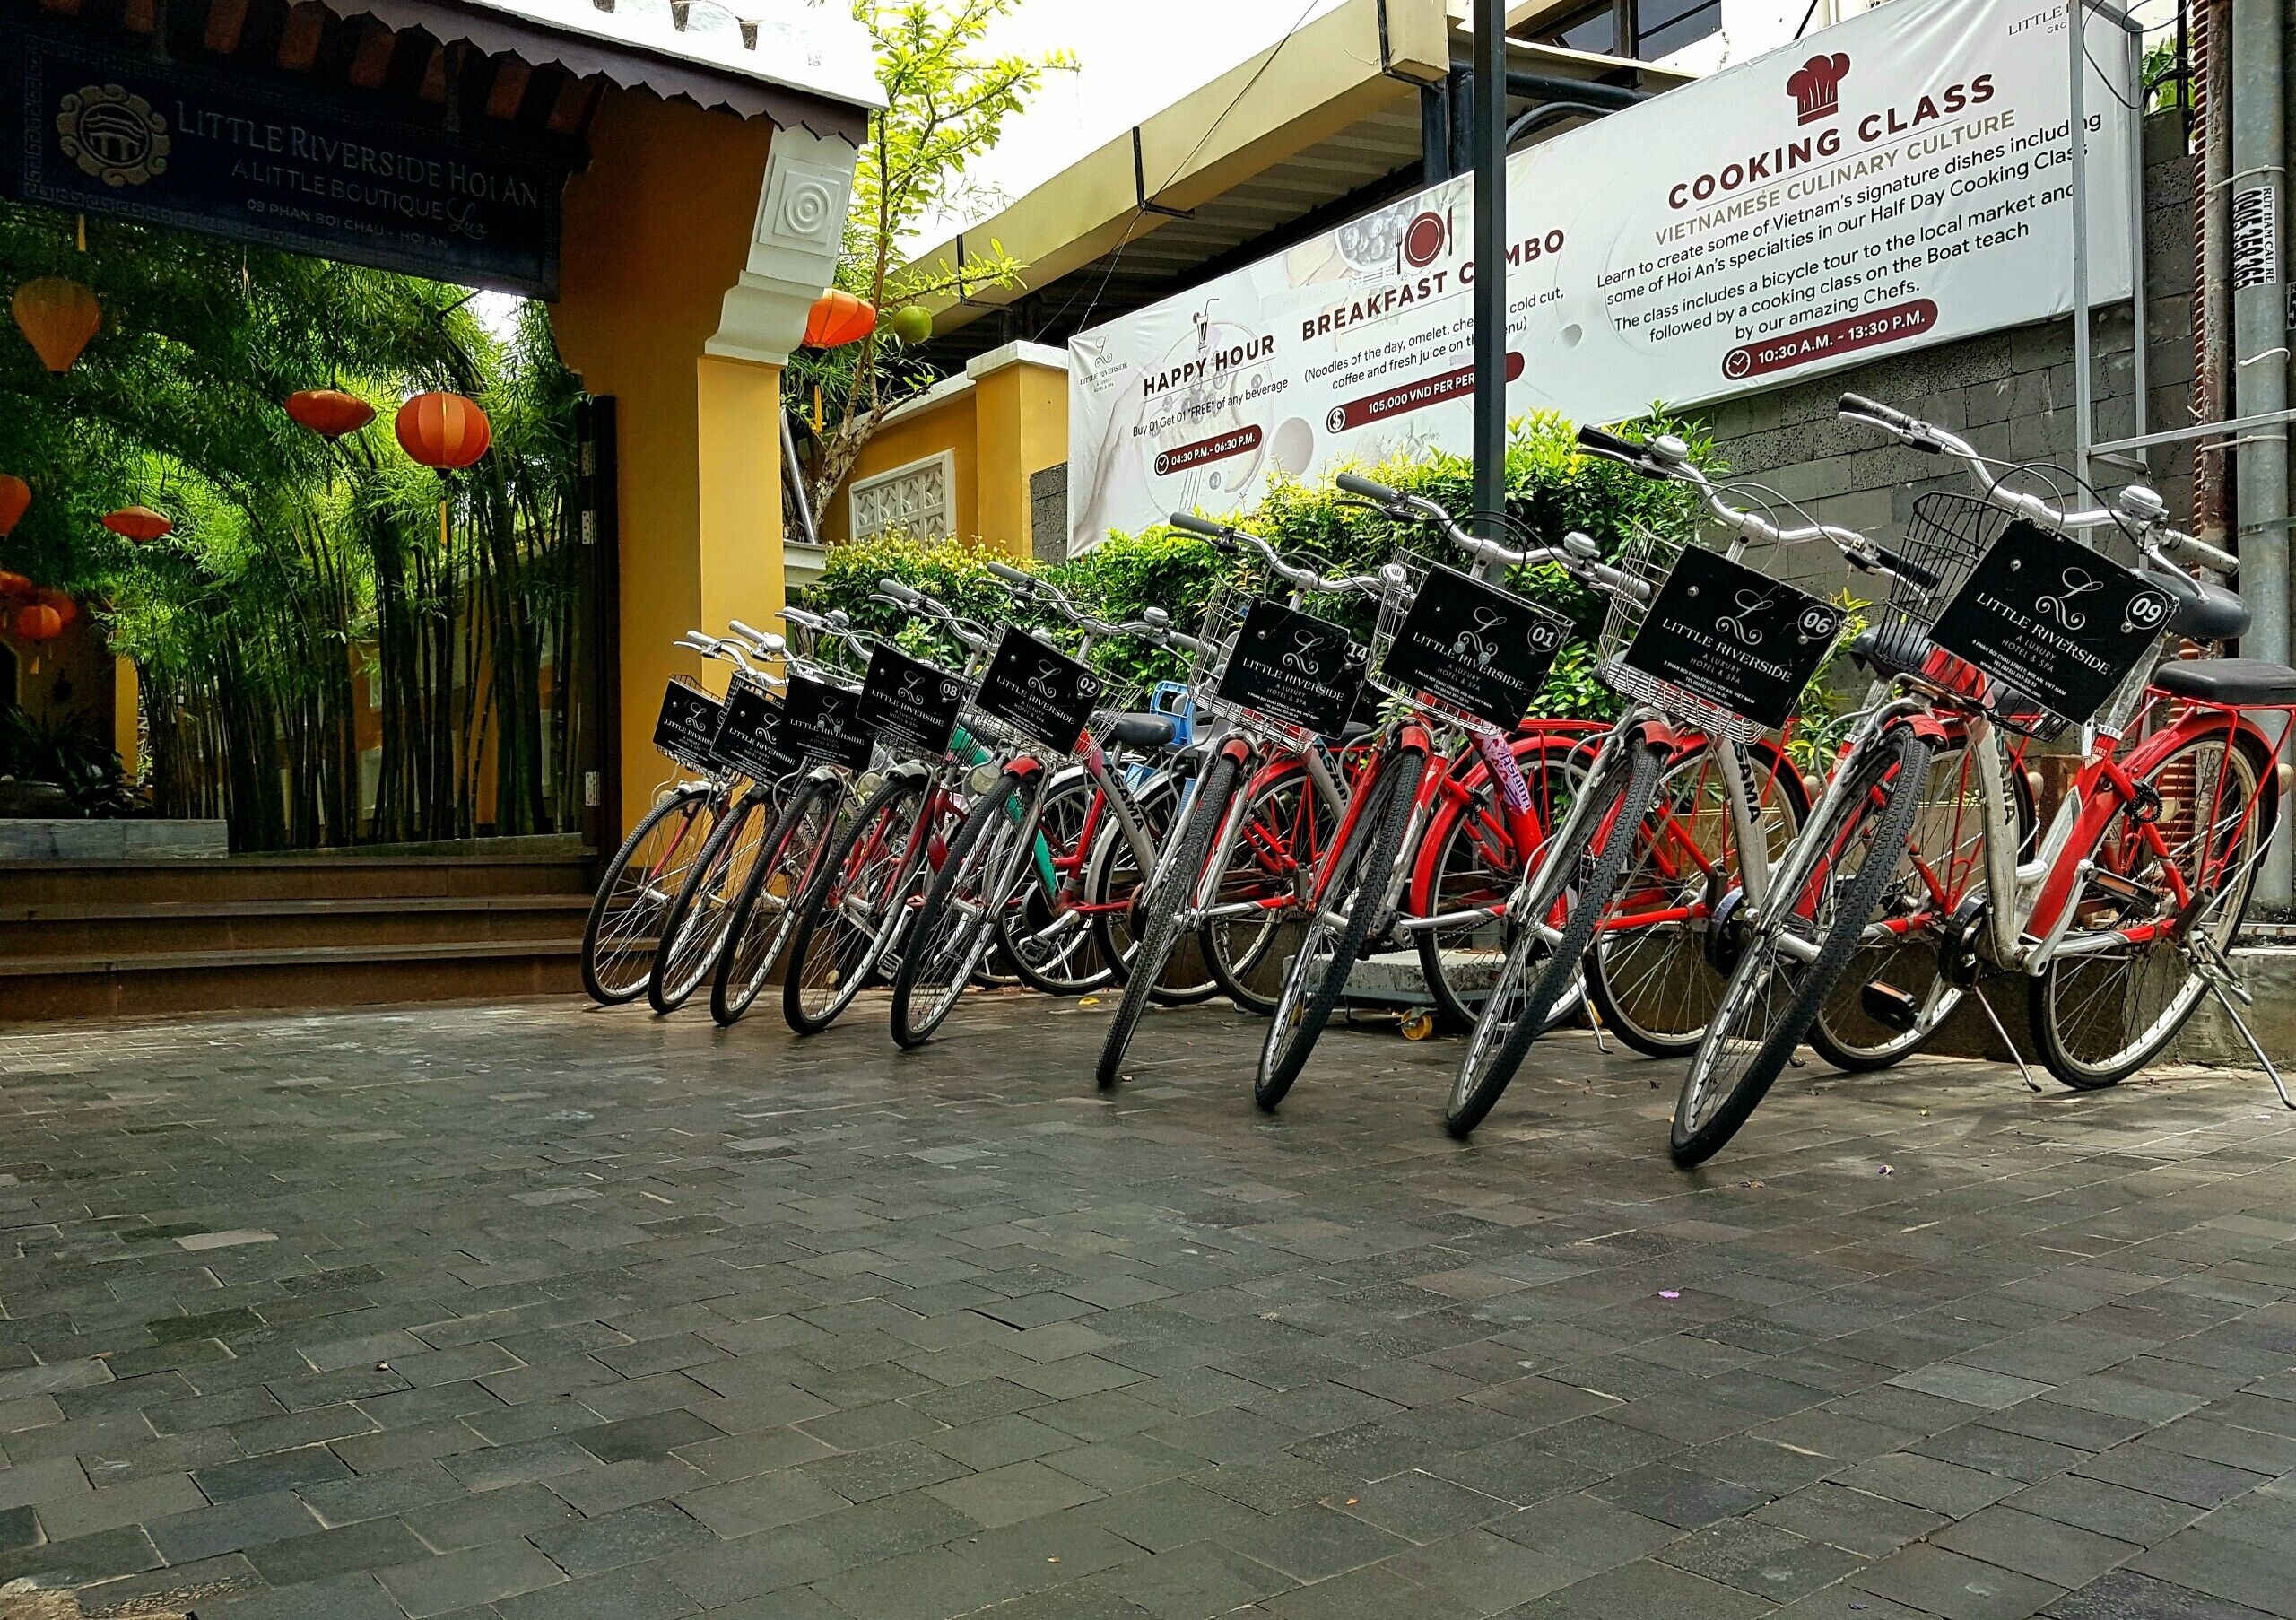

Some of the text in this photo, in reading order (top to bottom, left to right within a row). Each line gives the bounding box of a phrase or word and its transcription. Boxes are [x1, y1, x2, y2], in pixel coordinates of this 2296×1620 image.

[2009, 5, 2062, 35] LITTLE
[2047, 22, 2067, 34] GRO
[176, 100, 537, 208] LITTLE RIVERSIDE HOI AN
[1669, 74, 1994, 209] COOKING CLASS
[231, 159, 248, 179] A
[253, 162, 325, 196] LITTLE
[332, 179, 443, 220] BOUTIQUE
[1597, 113, 2101, 288] Learn to create some of Vietnam's signature dishes includng
[1656, 109, 2015, 245] VIETNAMESE CULINARY CULTURE
[270, 204, 310, 222] PHAN
[1607, 284, 1645, 306] some
[1648, 276, 1663, 296] of
[1667, 269, 1691, 287] Hoi
[1695, 257, 1726, 279] An's
[1729, 230, 1813, 272] specialties
[1818, 224, 1832, 240] in
[1839, 215, 1866, 233] our
[1871, 197, 1906, 224] Half
[1911, 189, 1945, 211] Day
[1950, 162, 2029, 197] Cooking
[1302, 229, 1564, 342] BREAKFAST CMBO
[1614, 318, 1639, 332] The
[1644, 301, 1679, 323] class
[1683, 284, 1744, 311] includes
[1749, 281, 1758, 292] a
[1762, 261, 1819, 289] bicycle
[1823, 248, 1859, 270] tour
[1864, 243, 1881, 258] to
[1886, 232, 1915, 250] the
[1920, 214, 1962, 242] local
[1968, 193, 2036, 227] market
[1649, 222, 2029, 342] followed by a cooking class on the Boat teach
[1735, 278, 1920, 341] by our amazing Chefs.
[1304, 358, 1348, 383] (Noodles
[1351, 350, 1361, 366] of
[1363, 343, 1381, 362] the
[1384, 335, 1405, 355] day,
[1408, 326, 1449, 348] omelet,
[1509, 296, 1536, 314] cold
[1539, 287, 1564, 305] cut,
[1758, 344, 1796, 365] 10:30
[1800, 334, 1833, 353] A.M.
[1848, 319, 1888, 341] 13:30
[1893, 309, 1926, 330] P.M.
[1080, 372, 1098, 386] LITTLE
[1099, 361, 1128, 379] RIVERSIDE
[1144, 357, 1207, 397] HAPPY
[1215, 335, 1274, 372] HOUR
[1332, 370, 1365, 390] coffee
[1367, 361, 1387, 379] and
[1388, 351, 1417, 372] fresh
[1418, 343, 1446, 365] juice
[1448, 340, 1464, 353] on
[1133, 424, 1148, 438] Buy
[1150, 422, 1158, 432] 01
[1160, 415, 1175, 429] Get
[1177, 410, 1186, 422] 01
[1216, 397, 1227, 410] of
[1227, 394, 1243, 407] any
[1245, 379, 1289, 401] beverage
[1368, 373, 1474, 414] 105,000 VND PER PER
[1170, 451, 1193, 466] 04:30
[1214, 440, 1237, 453] 06:30
[1238, 433, 1256, 448] P.M.
[1803, 612, 1831, 634] 06
[1976, 592, 2111, 675] LITTLE RIVERSIDE
[2132, 597, 2162, 622] 09
[1346, 643, 1368, 661] 14
[1413, 632, 1525, 690] LITTLE RIVERSIDE
[1532, 626, 1555, 648] 01
[1662, 618, 1793, 683] LITTLE RIVERSIDE
[2001, 638, 2054, 673] HOTEL & SPA
[2015, 634, 2057, 660] A LUXURY
[943, 683, 958, 697] 08
[996, 675, 1028, 698] LITTLE
[1029, 693, 1075, 725] RIVERSIDE
[1079, 677, 1096, 693] 02
[1243, 657, 1344, 701] LITTLE RIVERSIDE
[665, 719, 713, 746] LITTLE RIVERSI
[790, 719, 819, 732] LITTLE
[822, 727, 865, 745] RIVERSIDE
[872, 688, 944, 727] LITTLE RIVERSIDE
[728, 727, 755, 745] LITTLE
[756, 740, 796, 765] RIVERSIDE
[1102, 763, 1144, 832] ASAMA
[1313, 744, 1348, 807] ASAM
